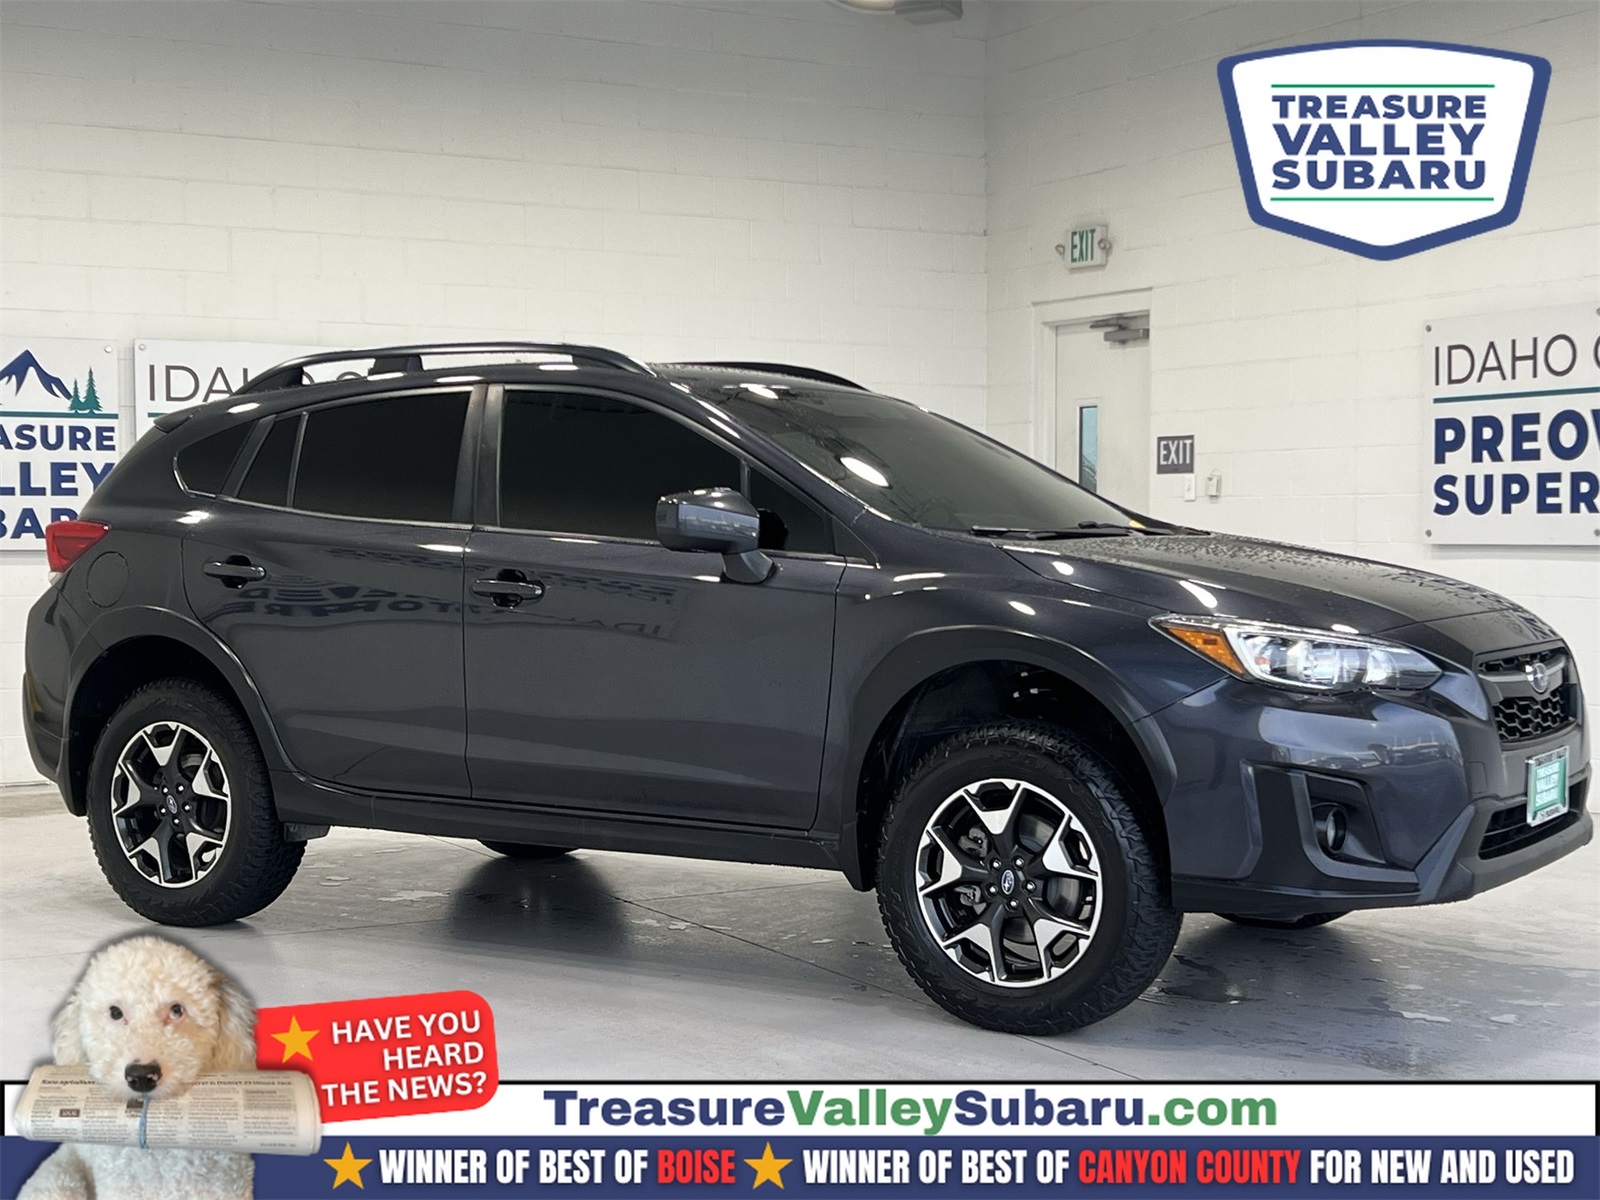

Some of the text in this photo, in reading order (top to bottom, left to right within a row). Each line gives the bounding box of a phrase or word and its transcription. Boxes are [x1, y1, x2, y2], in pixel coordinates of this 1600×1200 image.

[1070, 229, 1096, 263] EXIT
[1434, 334, 1577, 386] IDAHO
[1160, 439, 1192, 465] EXIT
[1433, 471, 1600, 516] SUPER
